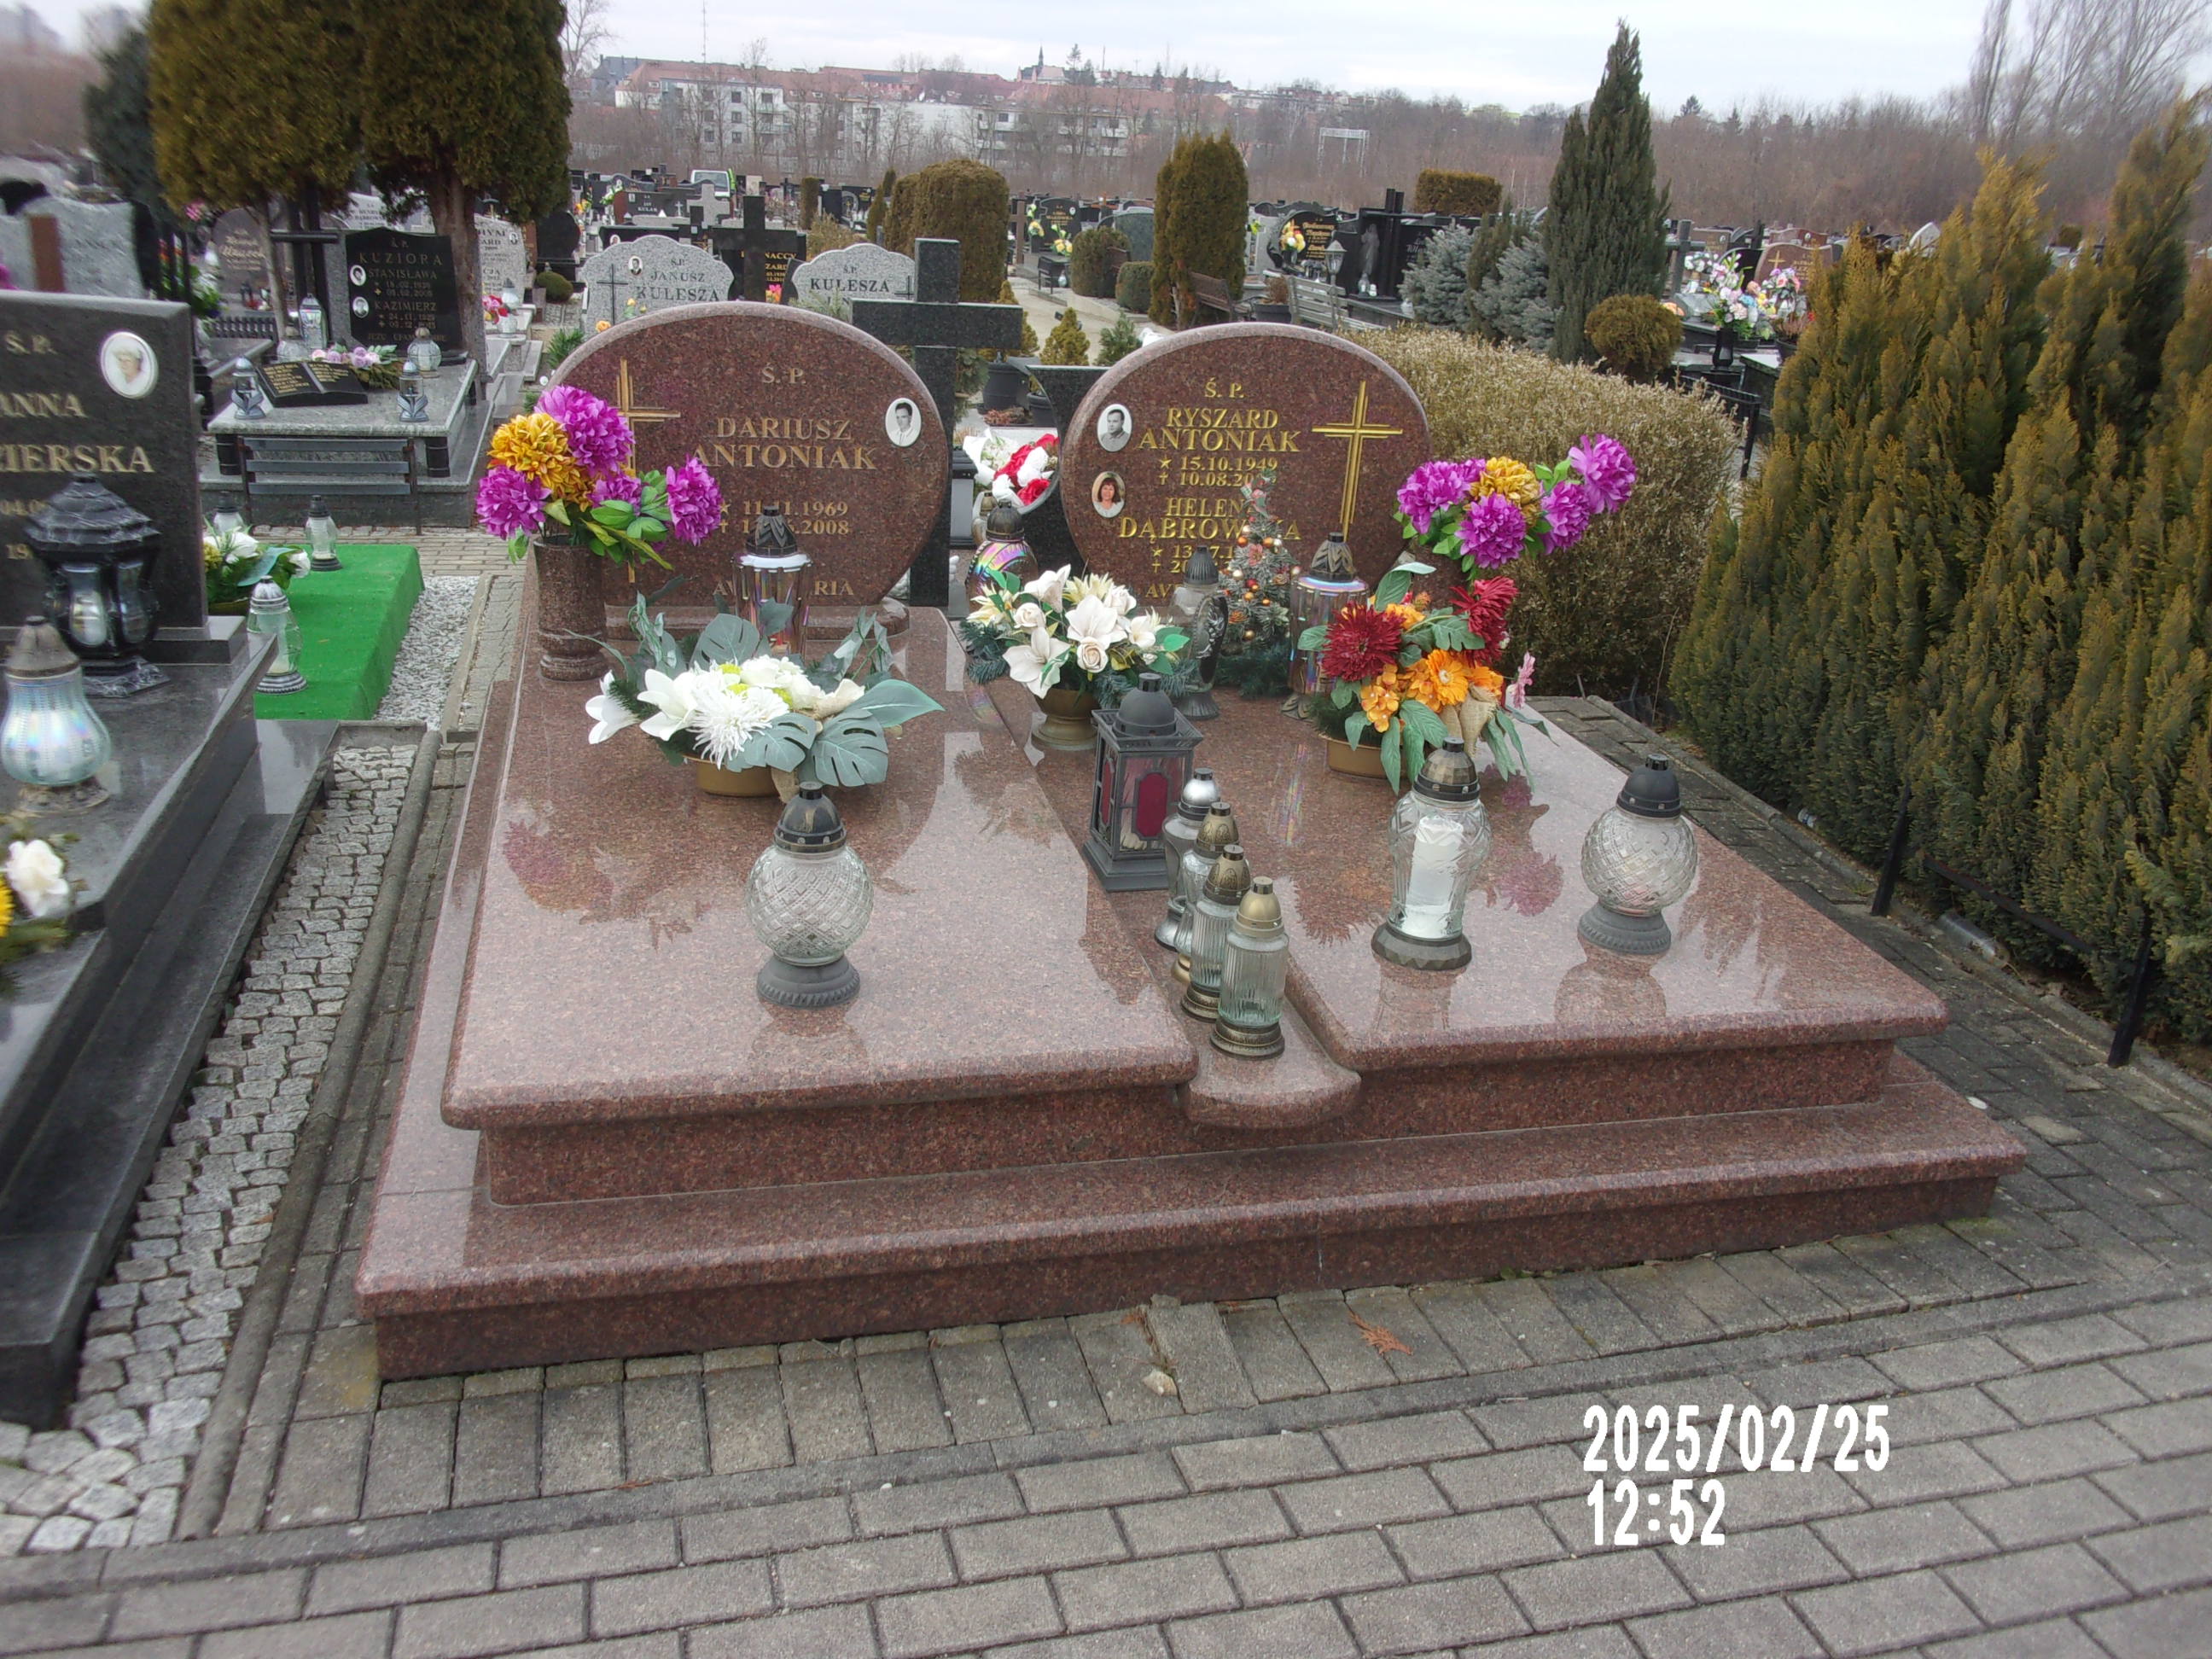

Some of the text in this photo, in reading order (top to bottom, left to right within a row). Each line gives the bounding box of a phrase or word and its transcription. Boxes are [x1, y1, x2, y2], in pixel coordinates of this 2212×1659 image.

[358, 252, 443, 265] KUZIORA
[650, 271, 706, 282] JANUSZ
[635, 286, 719, 301] KULESZA
[810, 278, 890, 293] KULESZA
[1166, 409, 1279, 428] RYSZARD
[715, 416, 853, 441] DARIUSZ
[1136, 428, 1301, 453] ANTONIAK
[0, 443, 156, 473] IERSKA
[690, 444, 877, 470] ANTONIAK
[1181, 457, 1278, 471] 15.10.1949
[1179, 472, 1278, 487] 10.08.20
[1119, 515, 1302, 544] DĄBROWA
